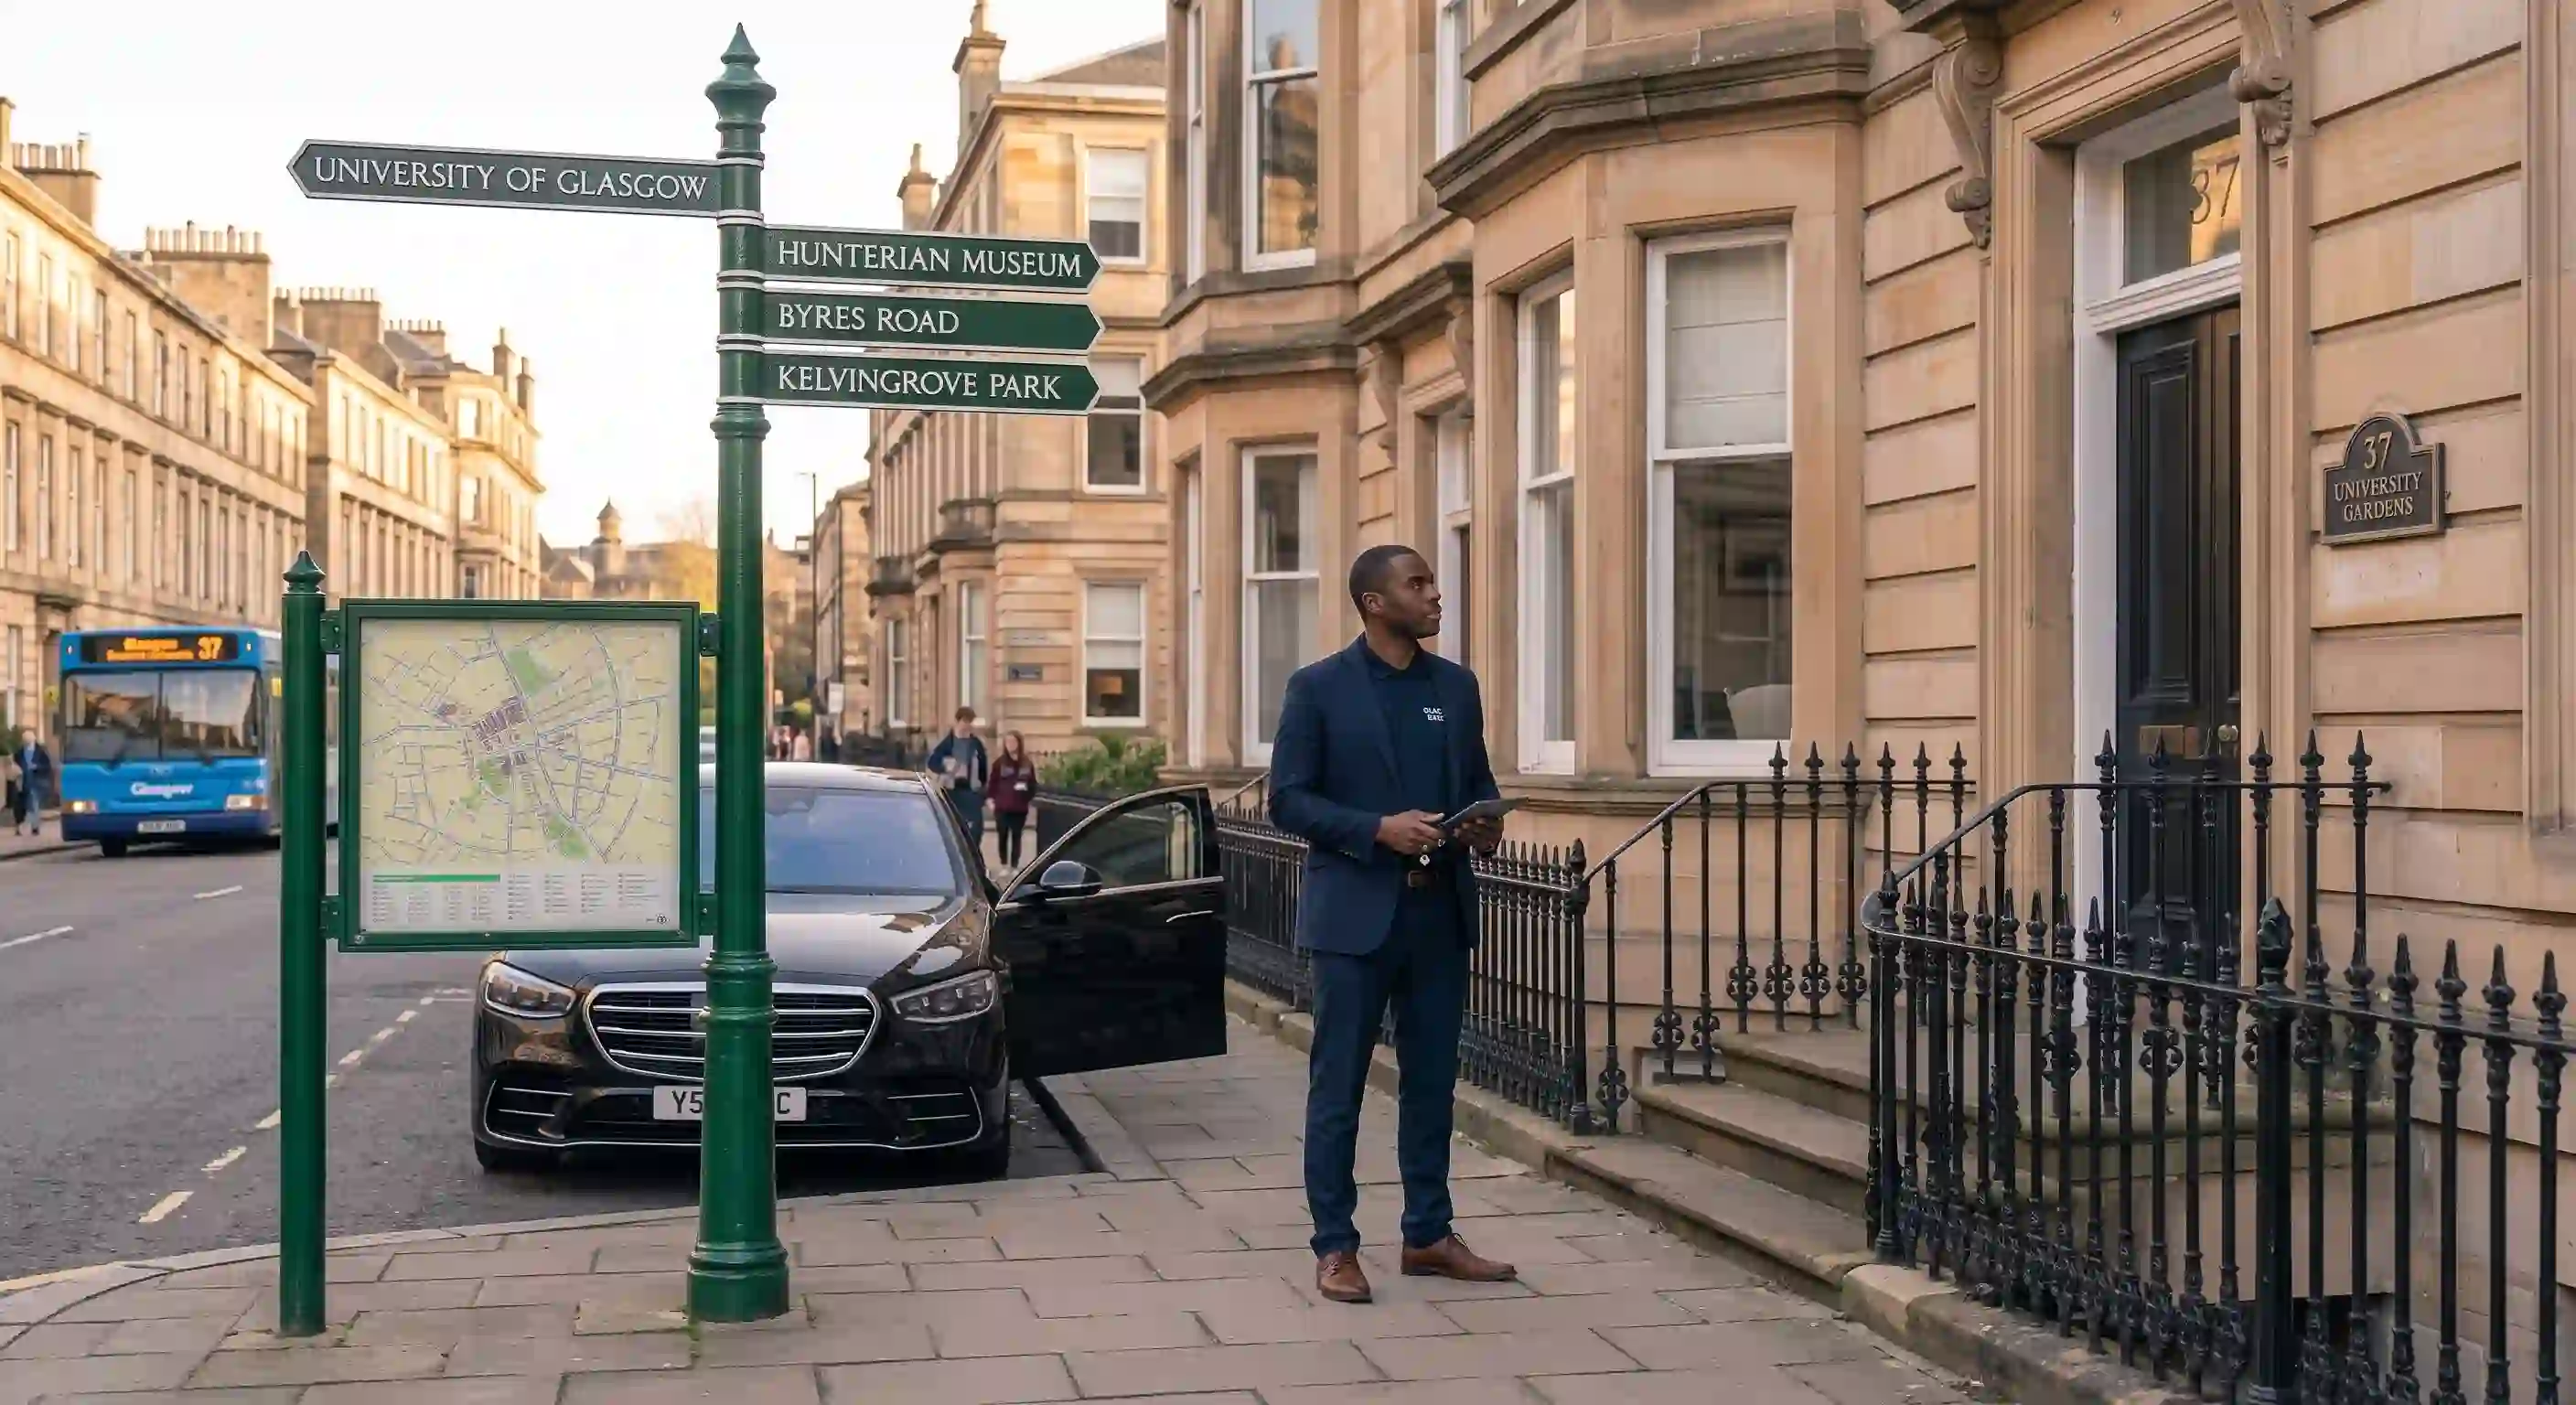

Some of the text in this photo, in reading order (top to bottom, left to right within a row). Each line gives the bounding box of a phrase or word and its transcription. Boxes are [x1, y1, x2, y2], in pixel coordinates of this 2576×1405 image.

[314, 156, 708, 200] UNIVERSITY OF GLASGOW
[2190, 156, 2239, 225] 37
[778, 241, 1081, 278] HUNTERIAN MUSEUM
[778, 303, 960, 335] BYRES ROAD
[778, 366, 1062, 401] KELVINGROVE PARK
[2364, 431, 2393, 470] 37
[2334, 471, 2422, 502] UNIVERSITY
[2344, 496, 2414, 522] GARDENS
[198, 636, 223, 660] 37
